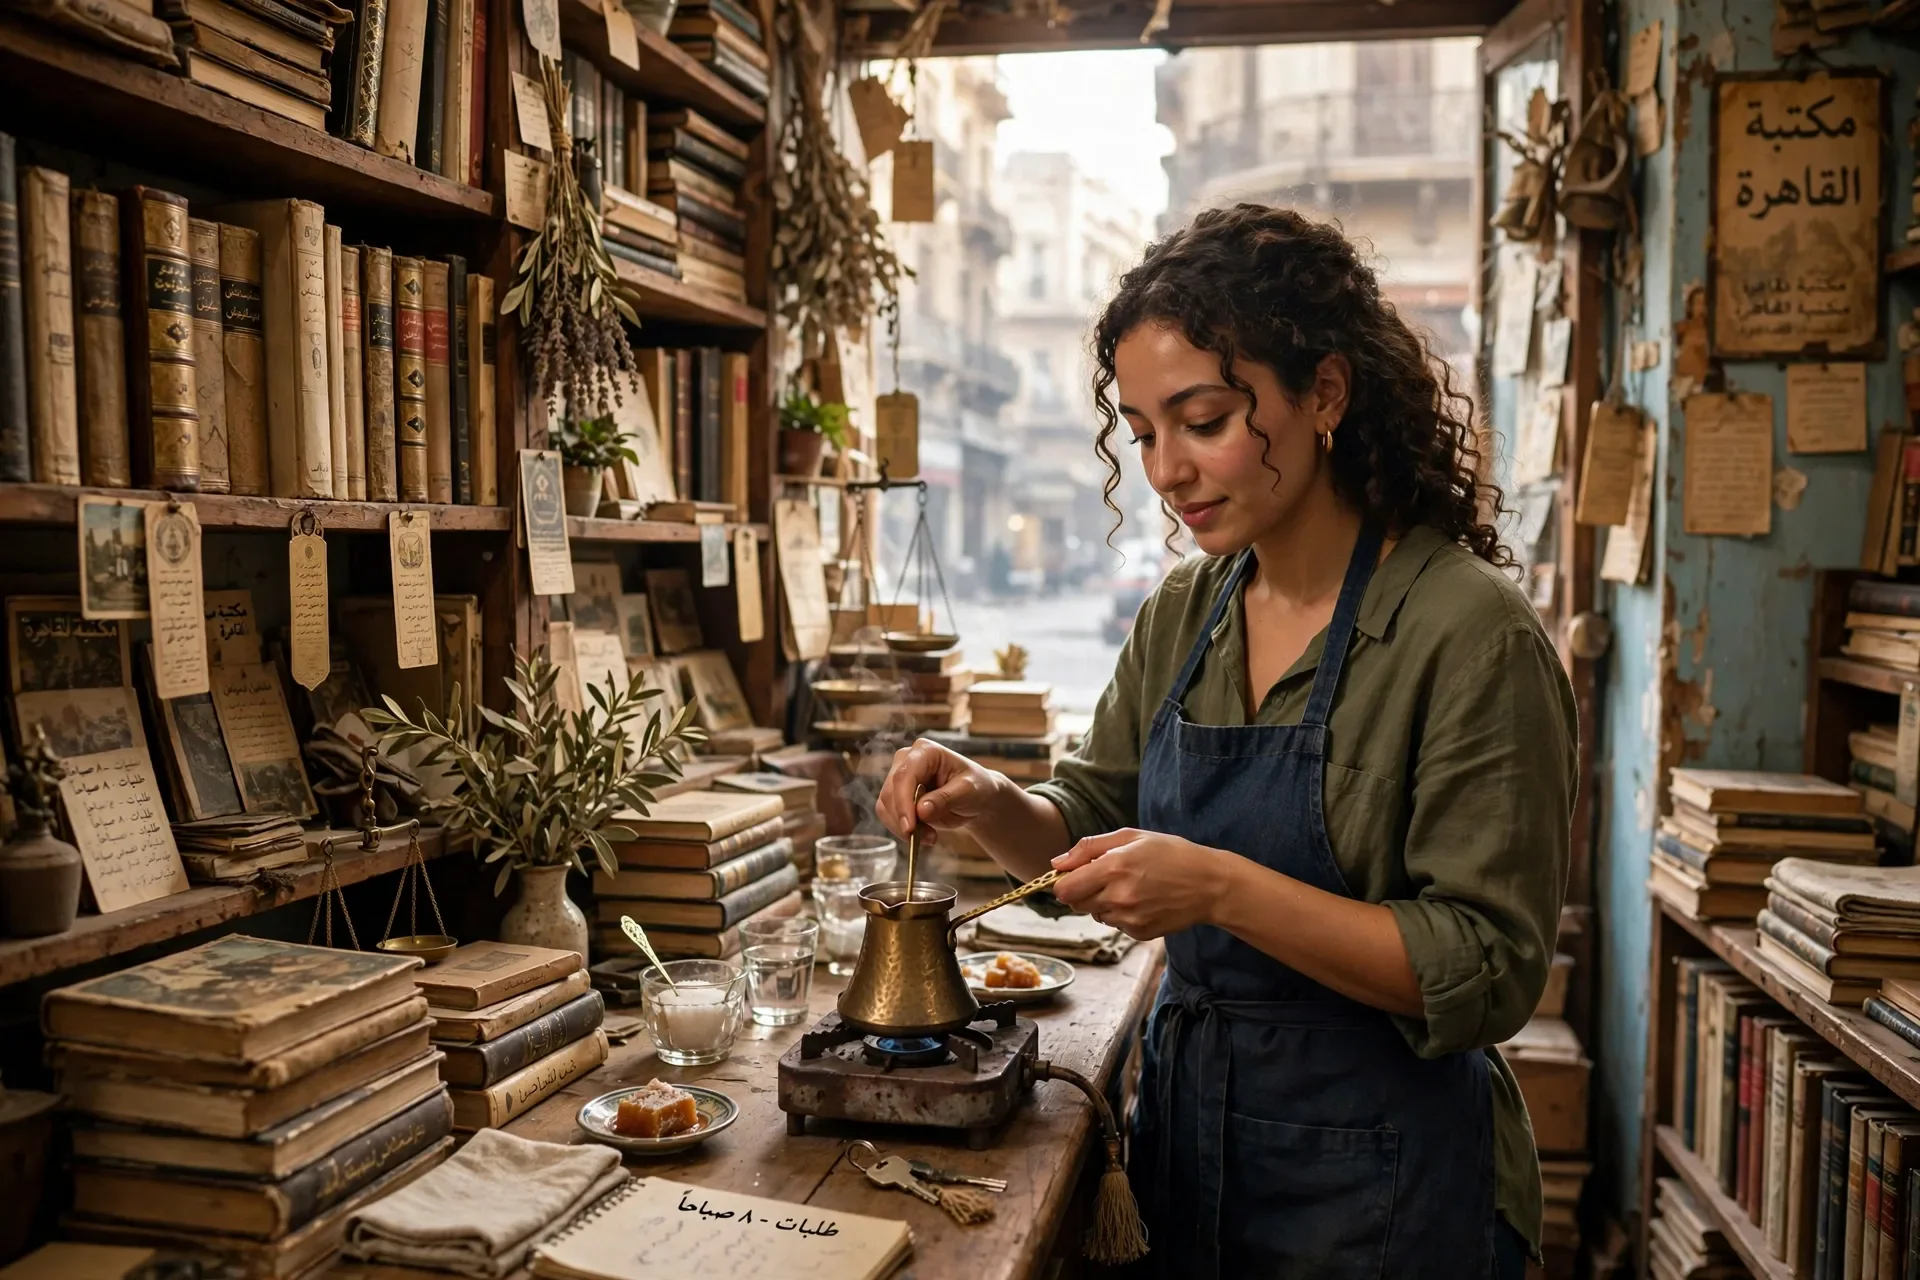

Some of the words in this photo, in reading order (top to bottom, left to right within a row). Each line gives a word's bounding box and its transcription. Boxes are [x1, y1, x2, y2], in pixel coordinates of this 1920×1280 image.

[1745, 95, 1856, 153] مكتبة
[1736, 165, 1861, 220] القاهرة
[737, 1209, 752, 1224] ٨
[775, 1218, 840, 1239] طلبات
